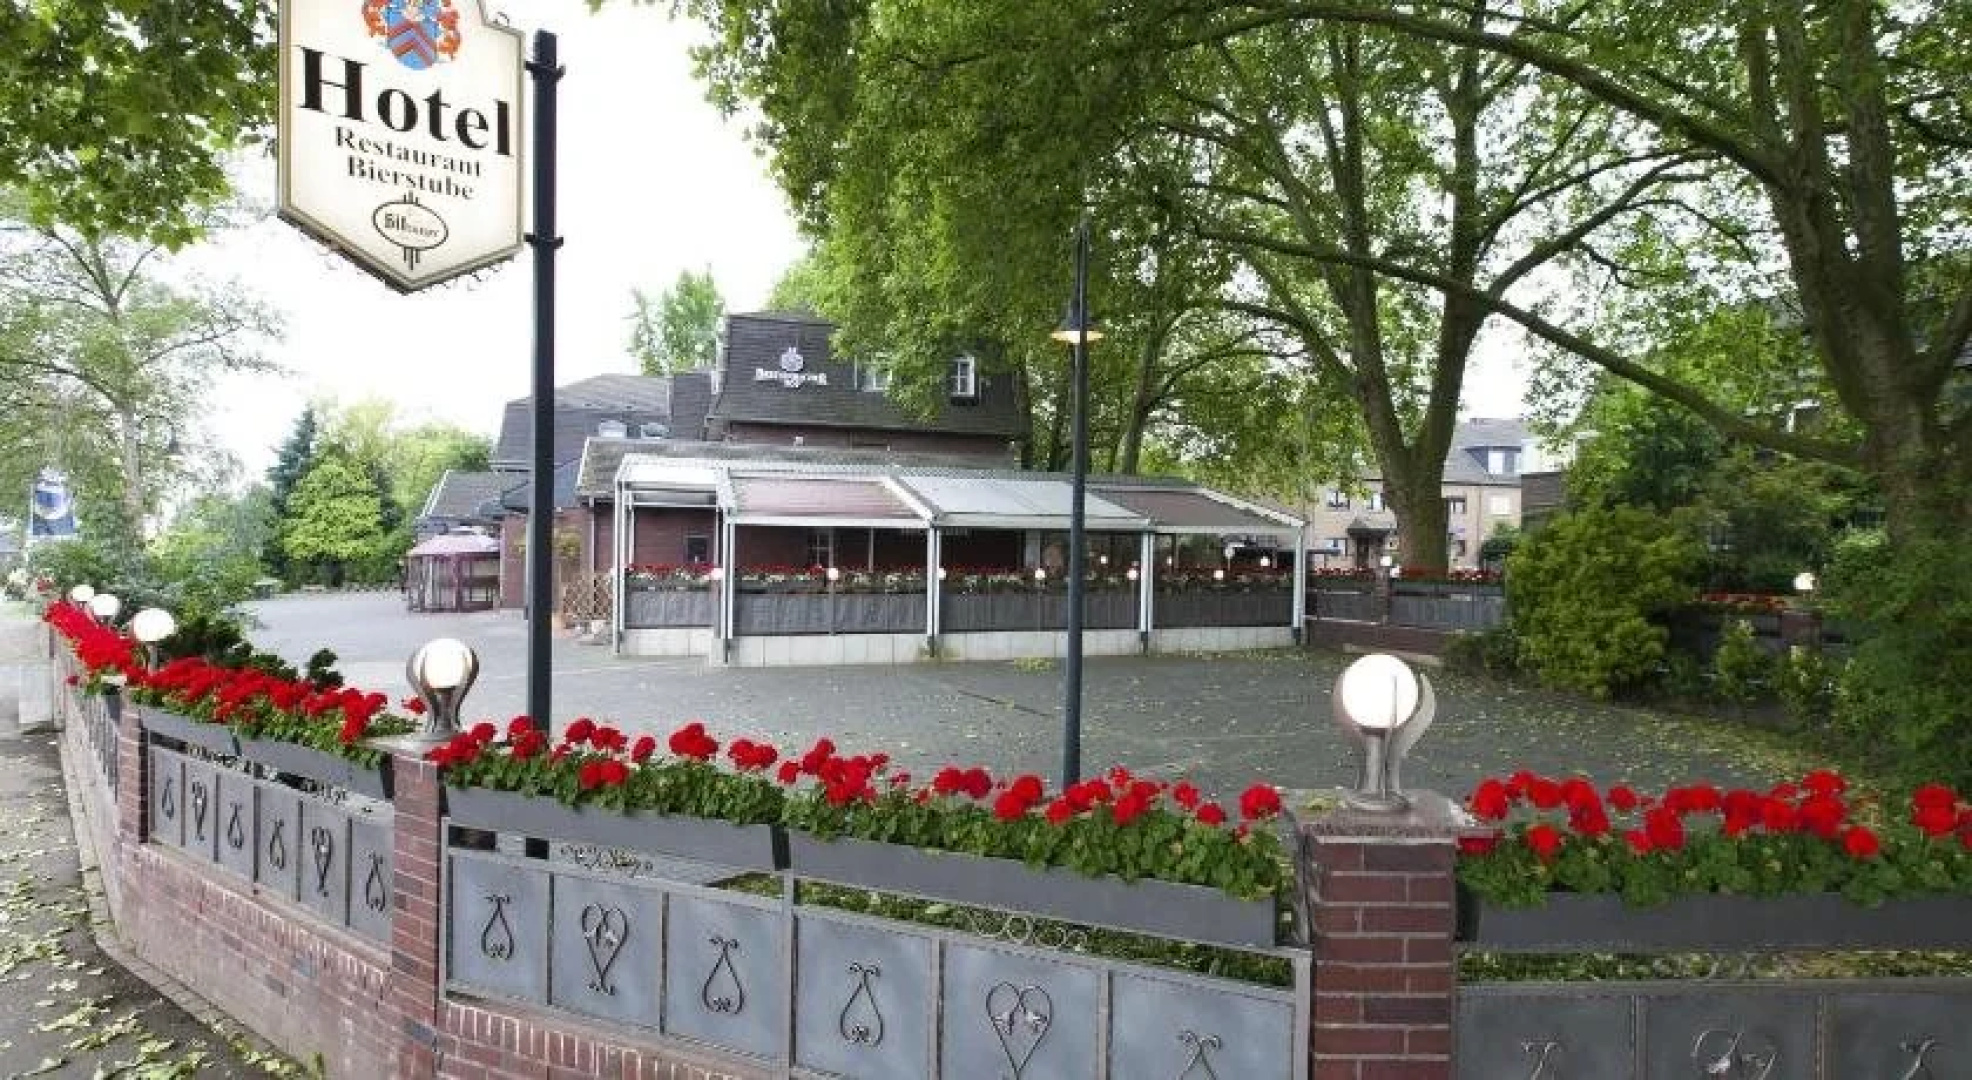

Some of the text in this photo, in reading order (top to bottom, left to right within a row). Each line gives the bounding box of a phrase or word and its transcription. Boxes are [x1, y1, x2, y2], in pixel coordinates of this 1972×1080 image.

[298, 45, 512, 156] Hotel
[335, 126, 481, 176] Restaurant
[348, 155, 474, 200] Bierstube
